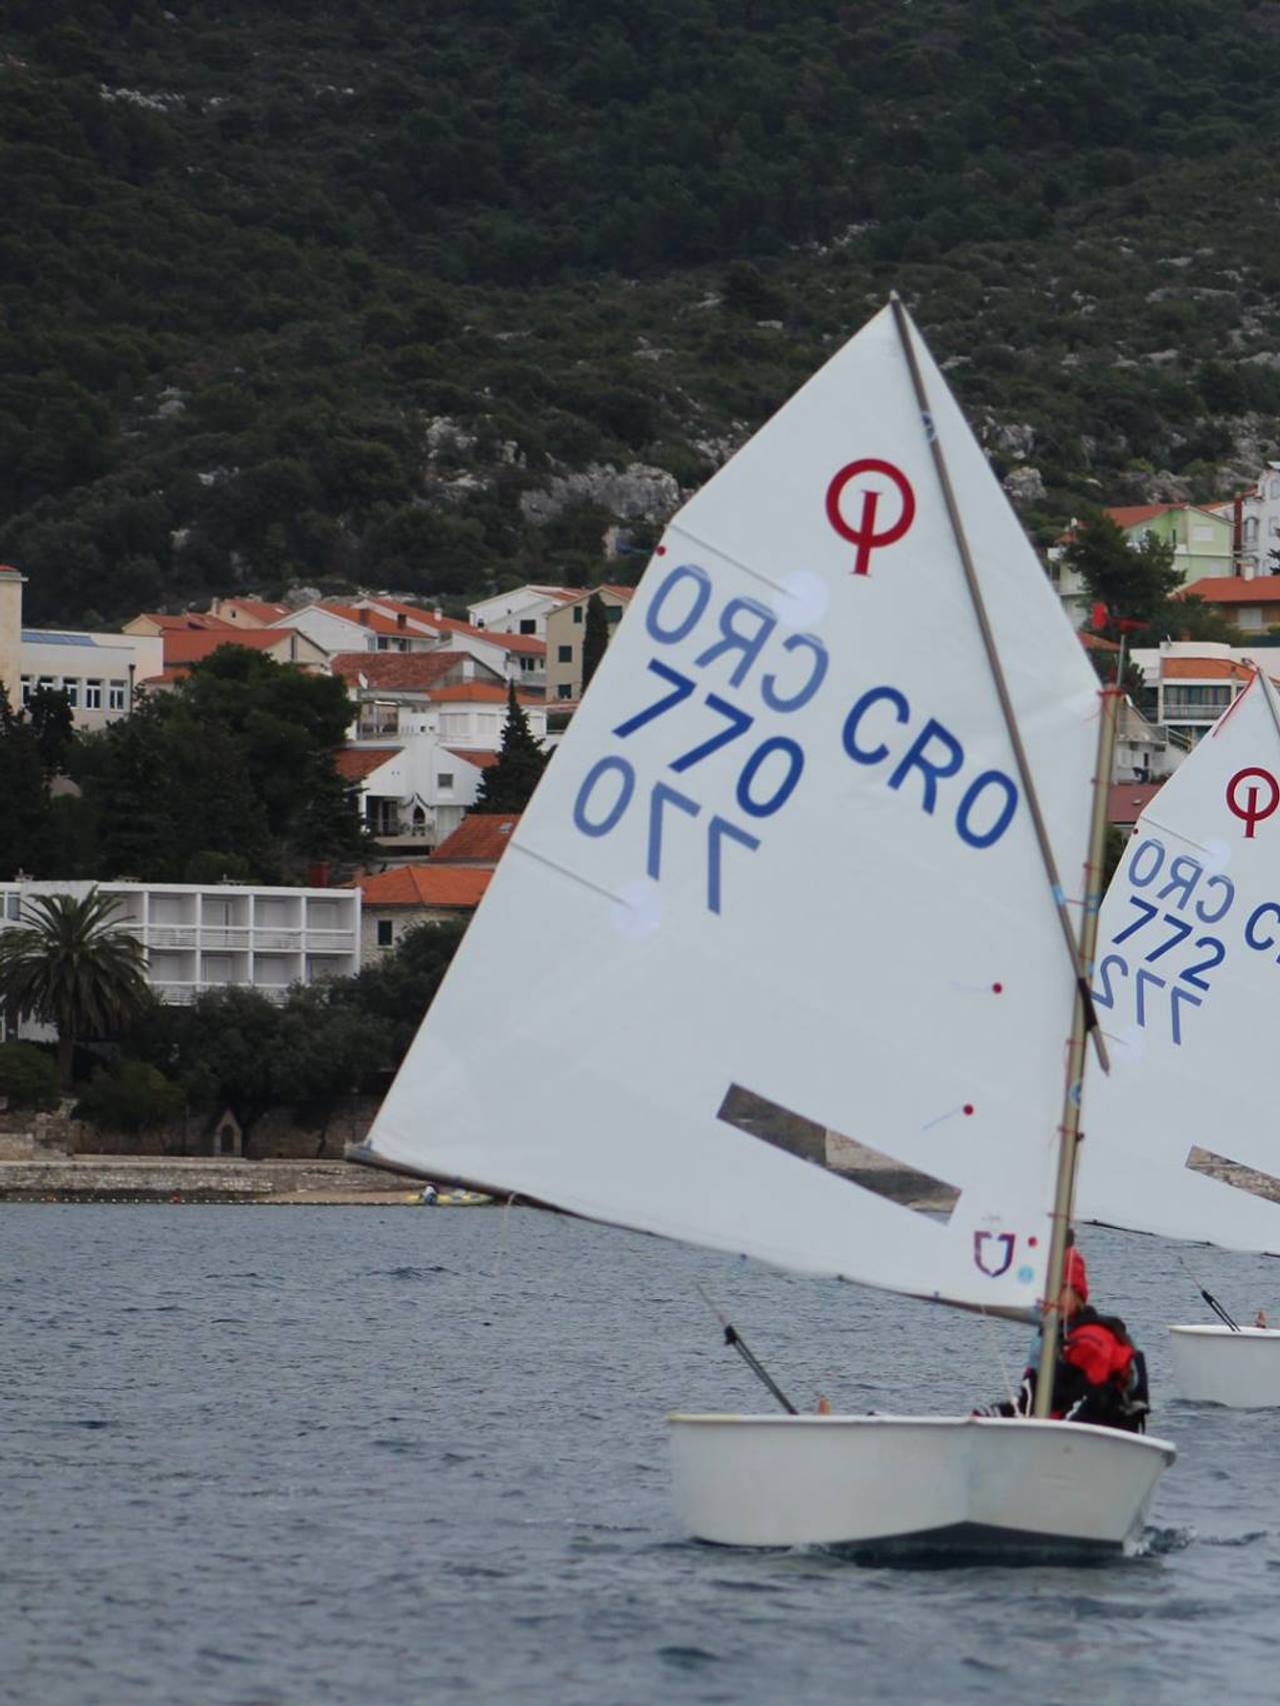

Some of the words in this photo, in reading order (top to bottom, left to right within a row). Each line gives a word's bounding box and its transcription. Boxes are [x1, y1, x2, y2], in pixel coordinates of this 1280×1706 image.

[611, 658, 805, 819] 770
[842, 686, 1020, 849] CRO
[1112, 896, 1226, 991] 772
